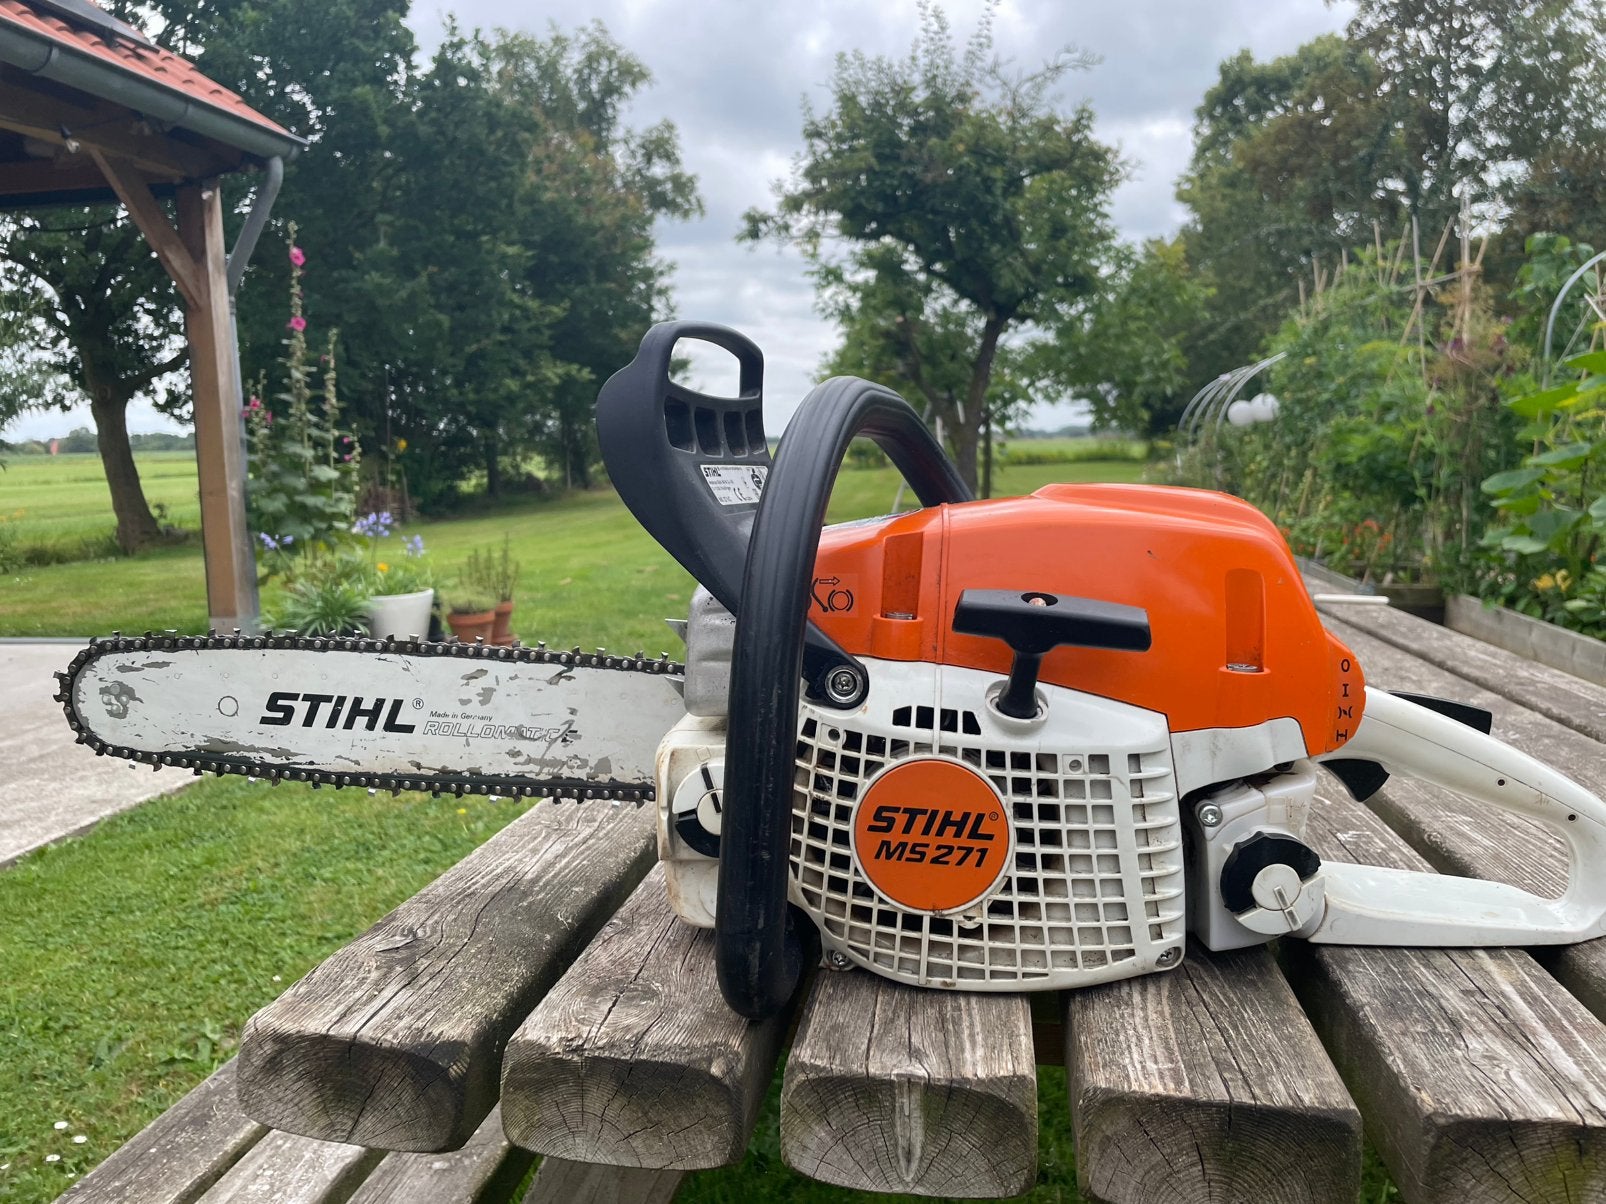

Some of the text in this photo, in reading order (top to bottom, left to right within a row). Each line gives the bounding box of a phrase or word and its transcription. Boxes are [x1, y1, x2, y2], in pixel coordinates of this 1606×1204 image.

[259, 691, 416, 734] STIHL
[867, 805, 995, 841] STIHL
[874, 840, 989, 868] MS 271
